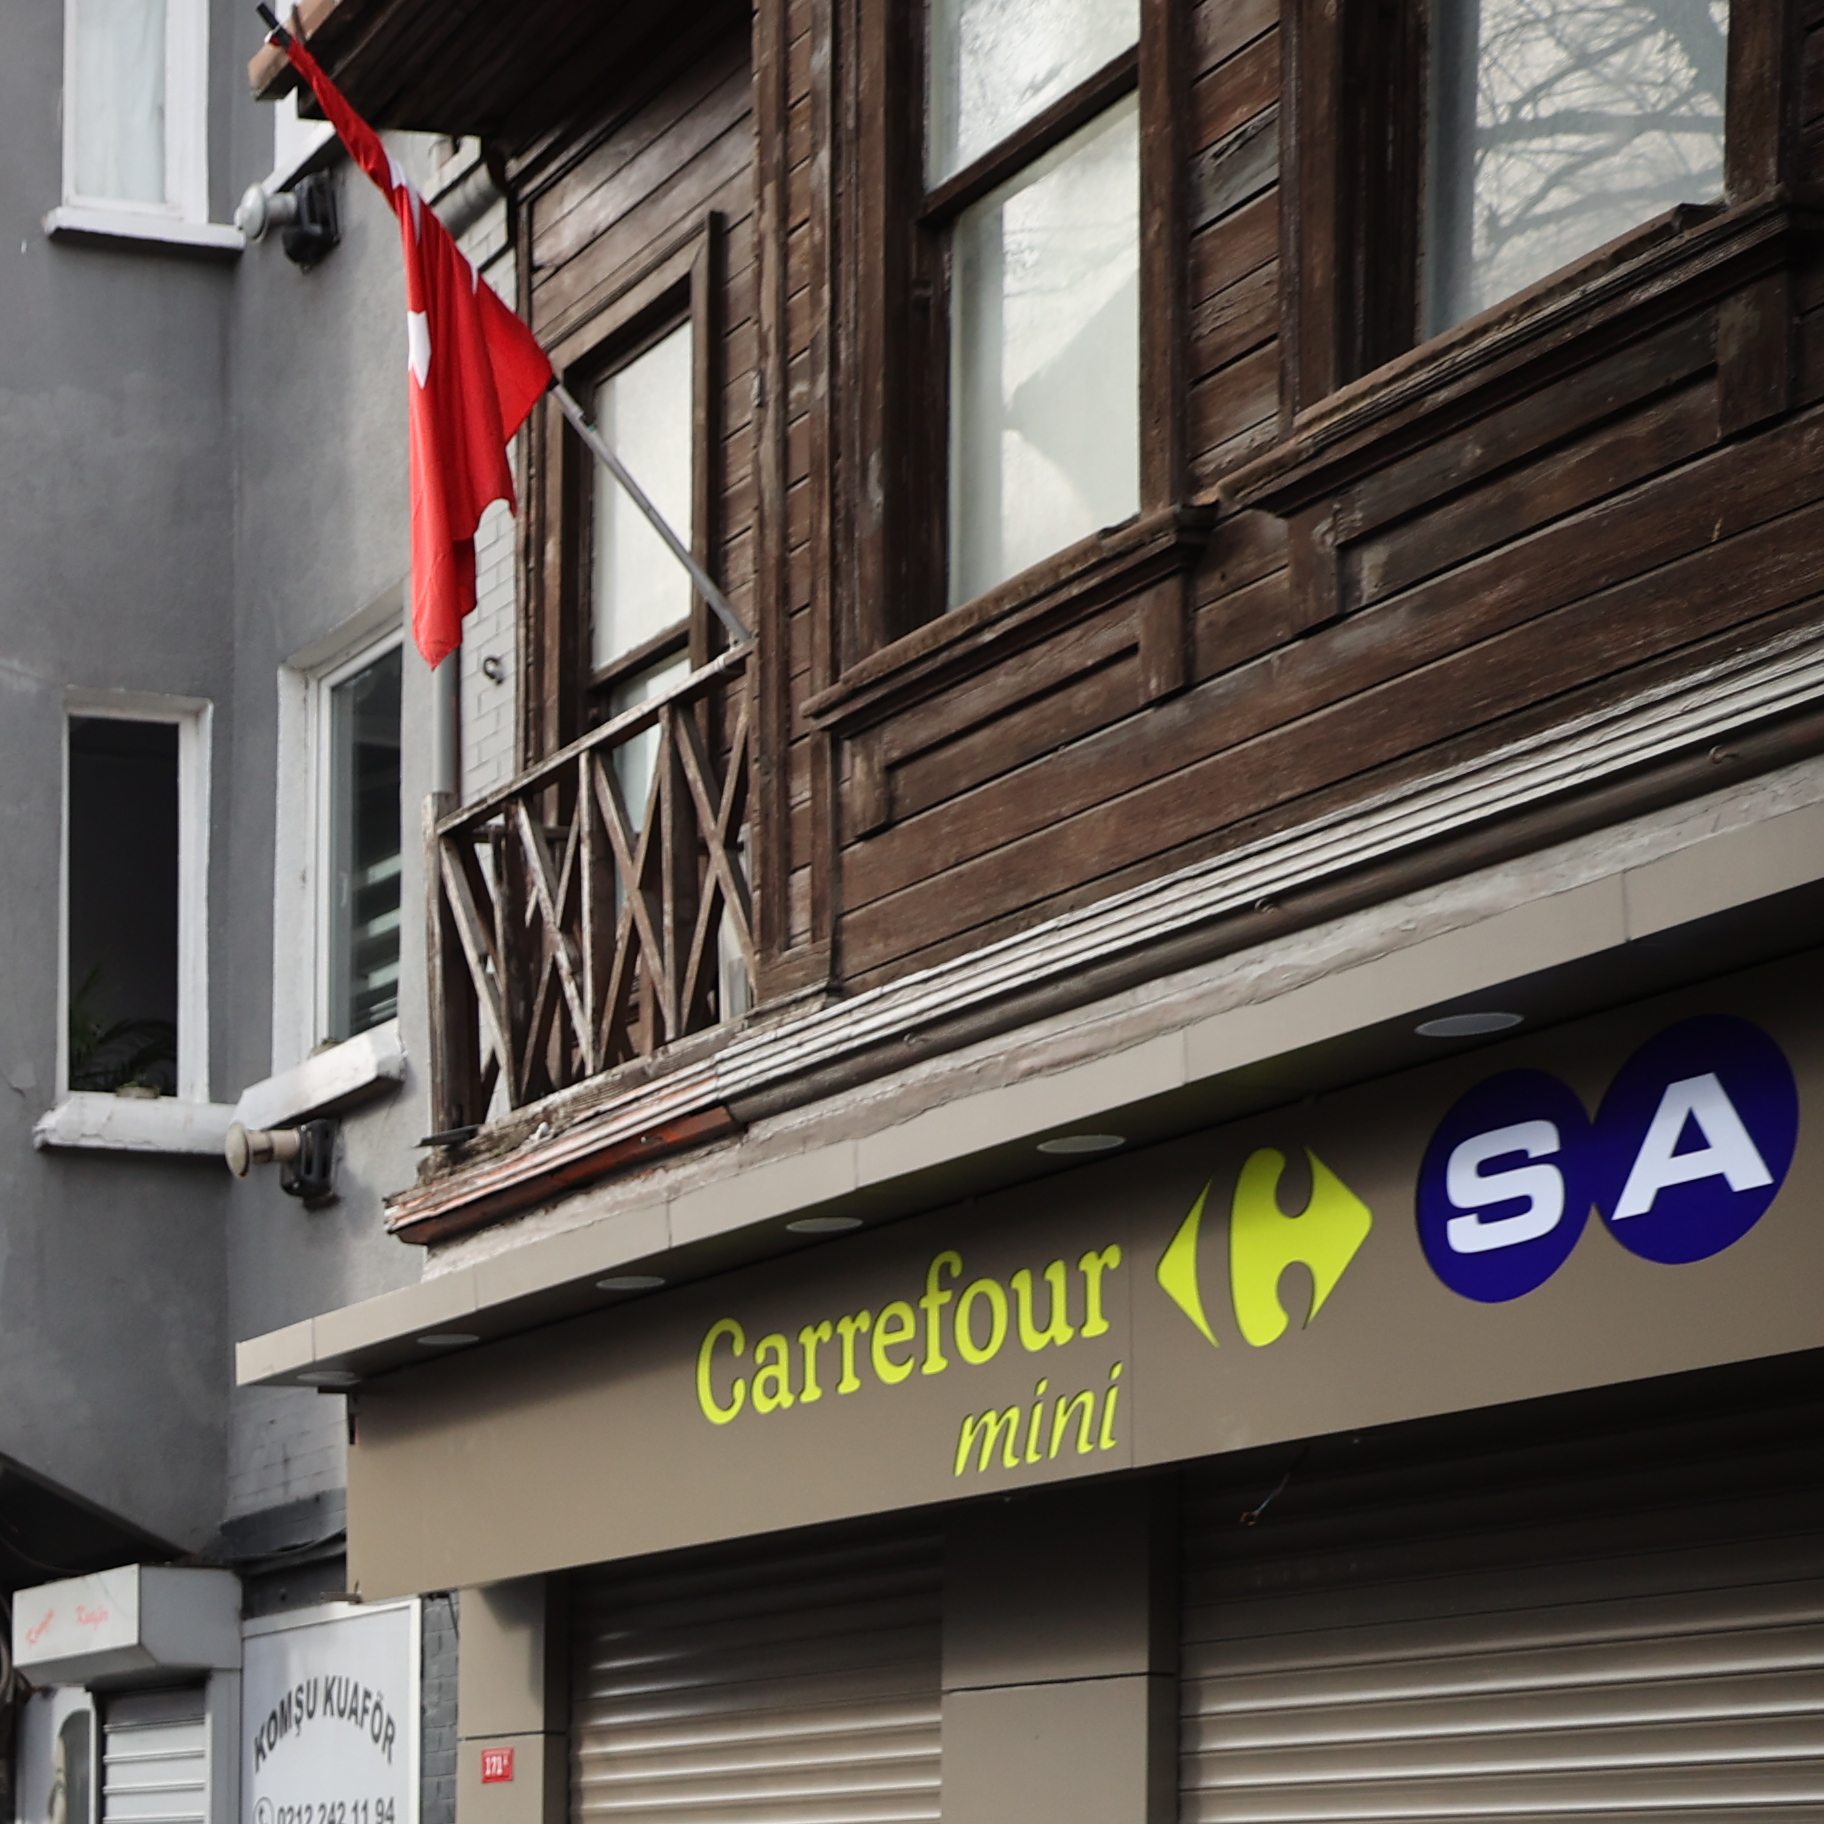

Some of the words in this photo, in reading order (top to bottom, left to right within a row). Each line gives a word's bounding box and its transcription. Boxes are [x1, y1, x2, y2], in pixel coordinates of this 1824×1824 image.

[695, 1243, 1122, 1426] Carrefour
[954, 1361, 1124, 1478] mini
[254, 1677, 319, 1773] KOMŞU
[322, 1675, 397, 1766] KUAFÖR
